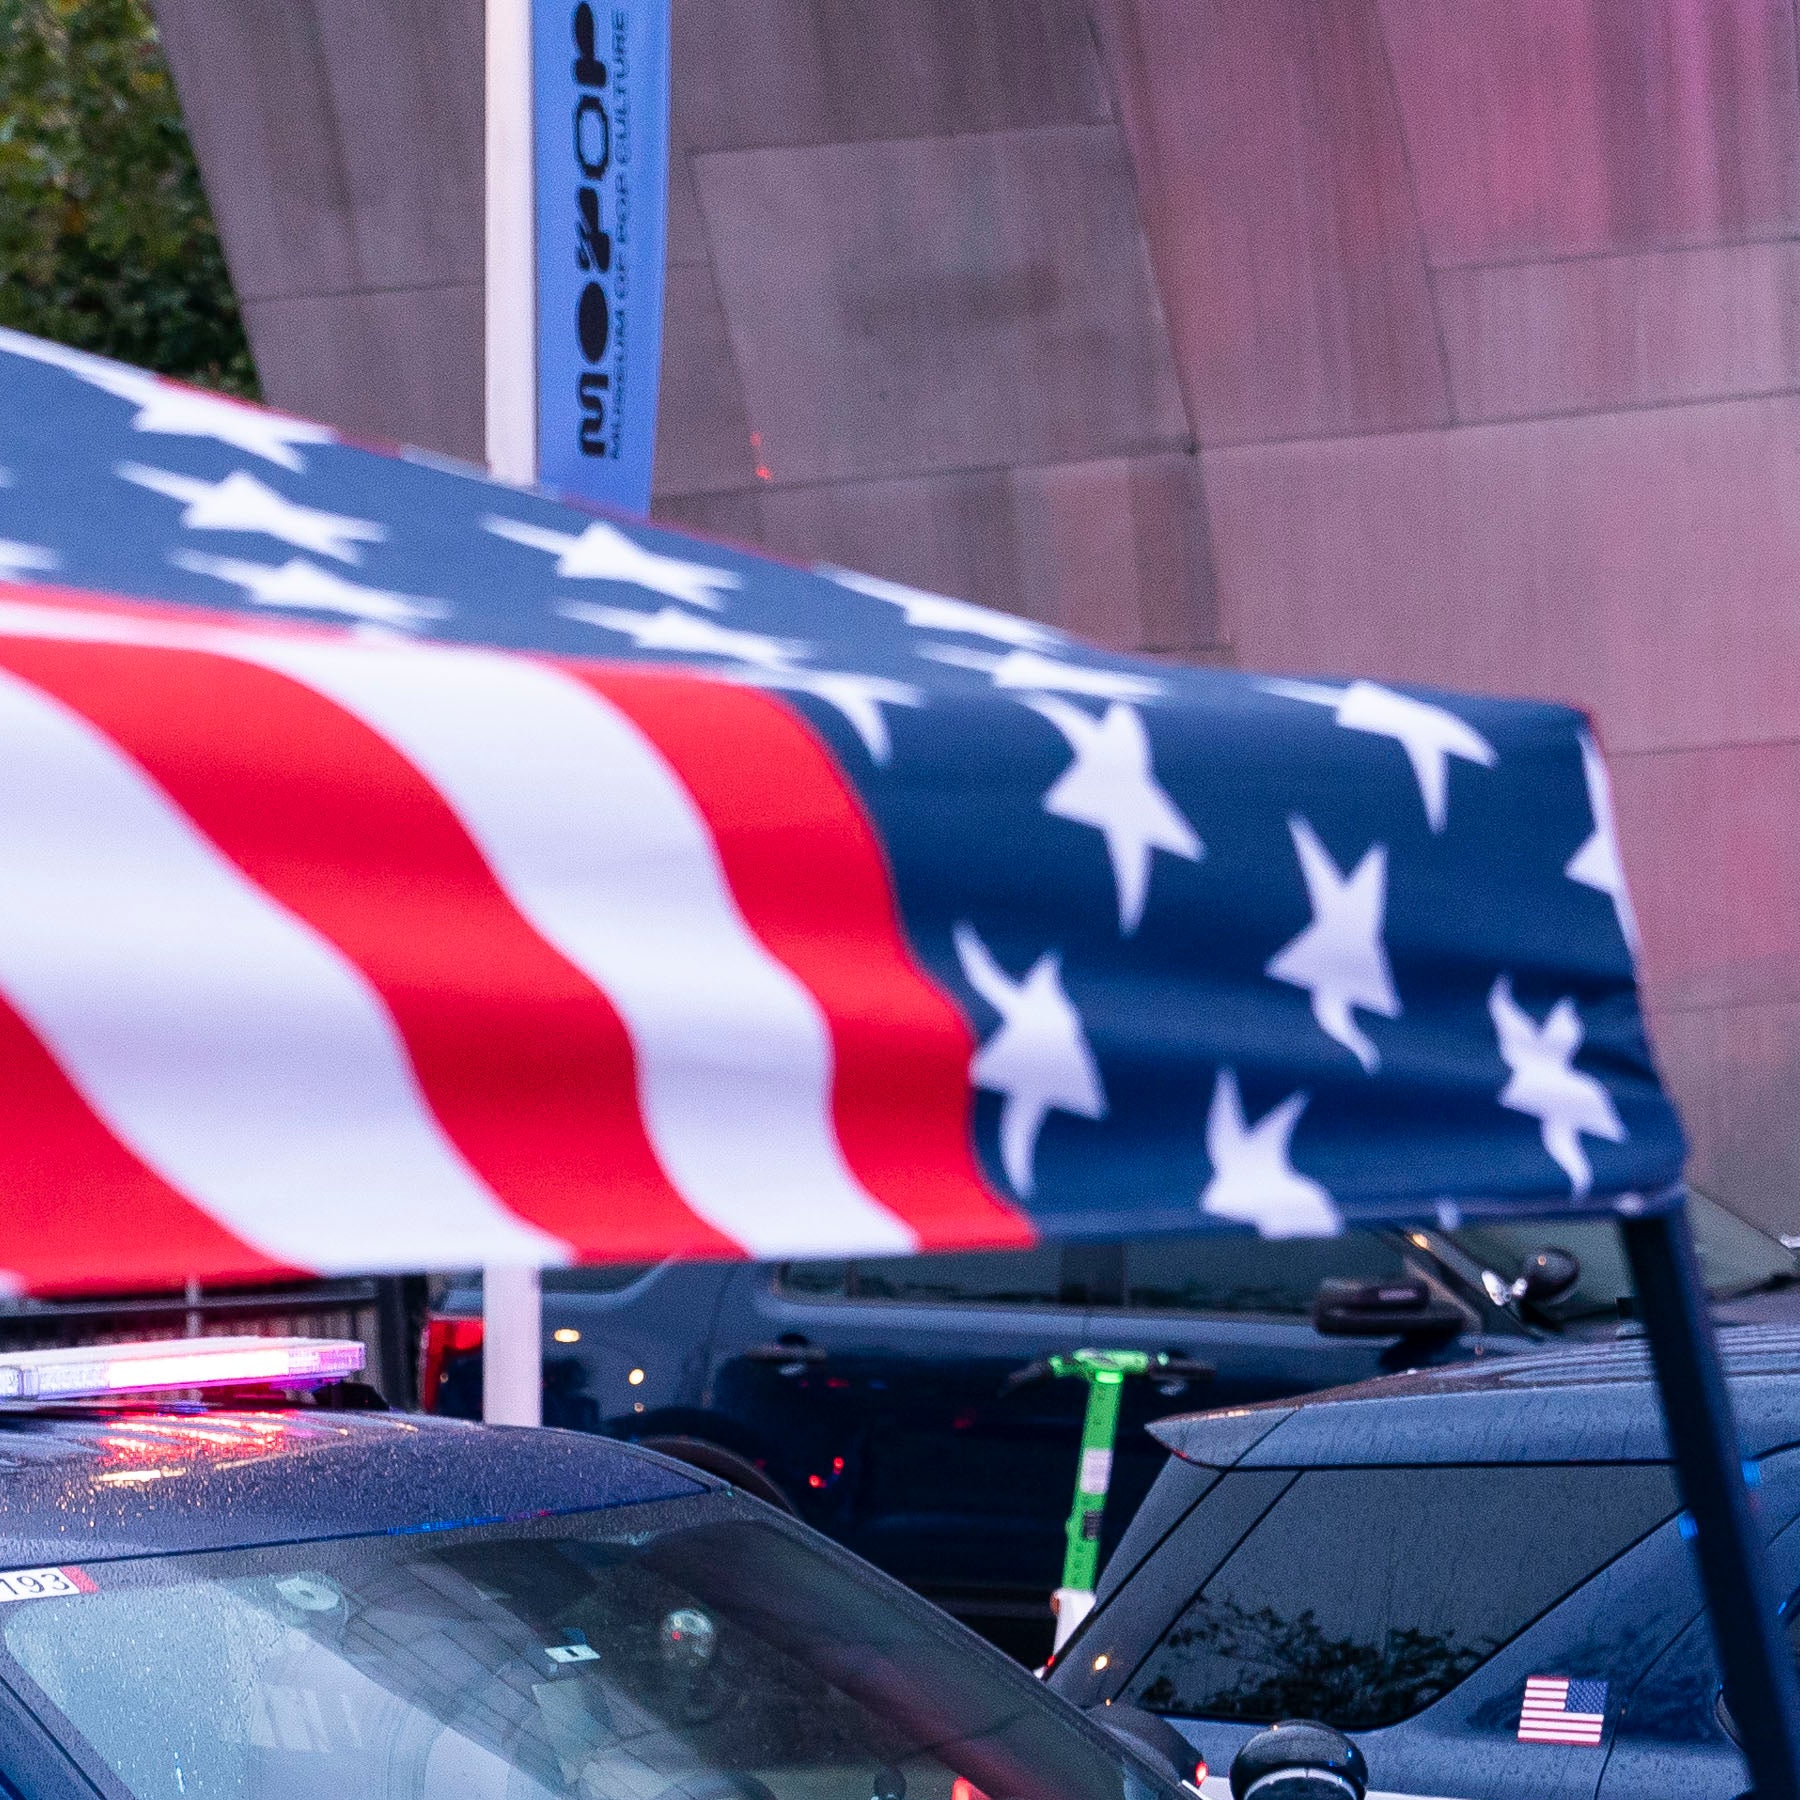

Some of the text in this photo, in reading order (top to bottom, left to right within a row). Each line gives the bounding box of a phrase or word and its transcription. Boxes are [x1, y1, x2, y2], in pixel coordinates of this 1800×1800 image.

[611, 9, 631, 166] CULTURE
[614, 173, 630, 246] POP
[612, 250, 628, 300] OF
